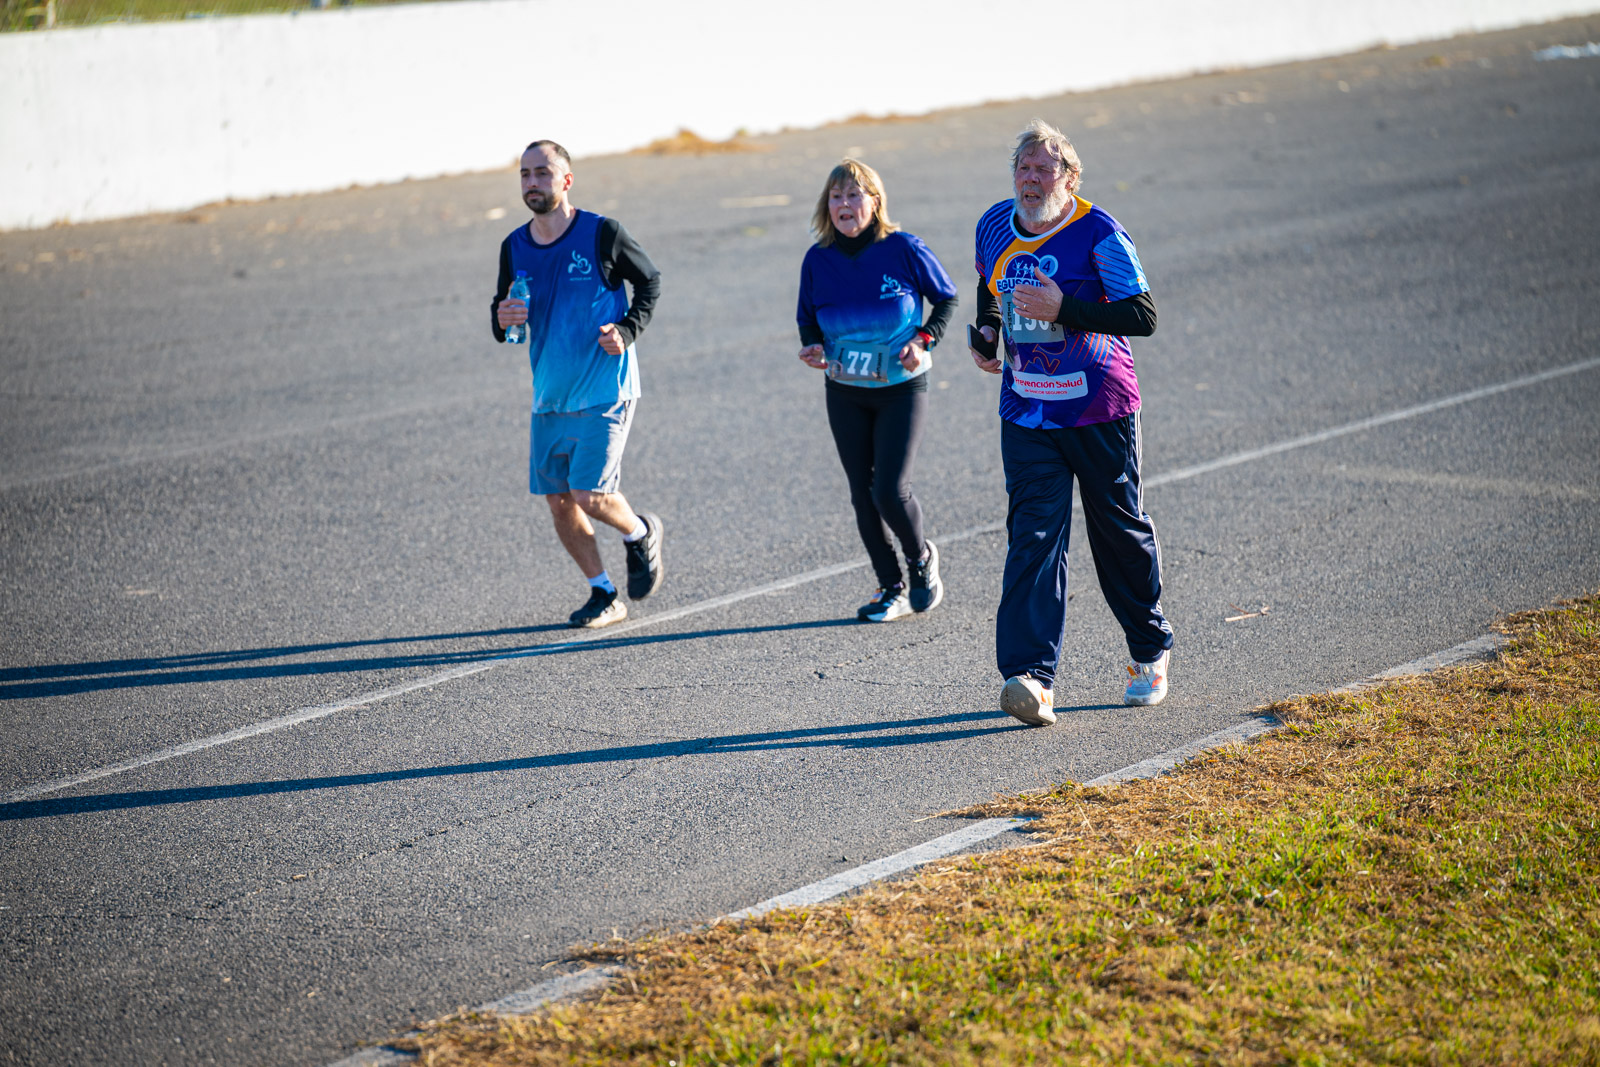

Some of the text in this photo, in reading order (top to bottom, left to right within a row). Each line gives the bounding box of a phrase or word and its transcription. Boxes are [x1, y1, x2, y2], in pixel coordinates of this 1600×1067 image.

[1042, 260, 1051, 273] 4
[847, 350, 872, 376] 77
[1055, 377, 1084, 389] Salud
